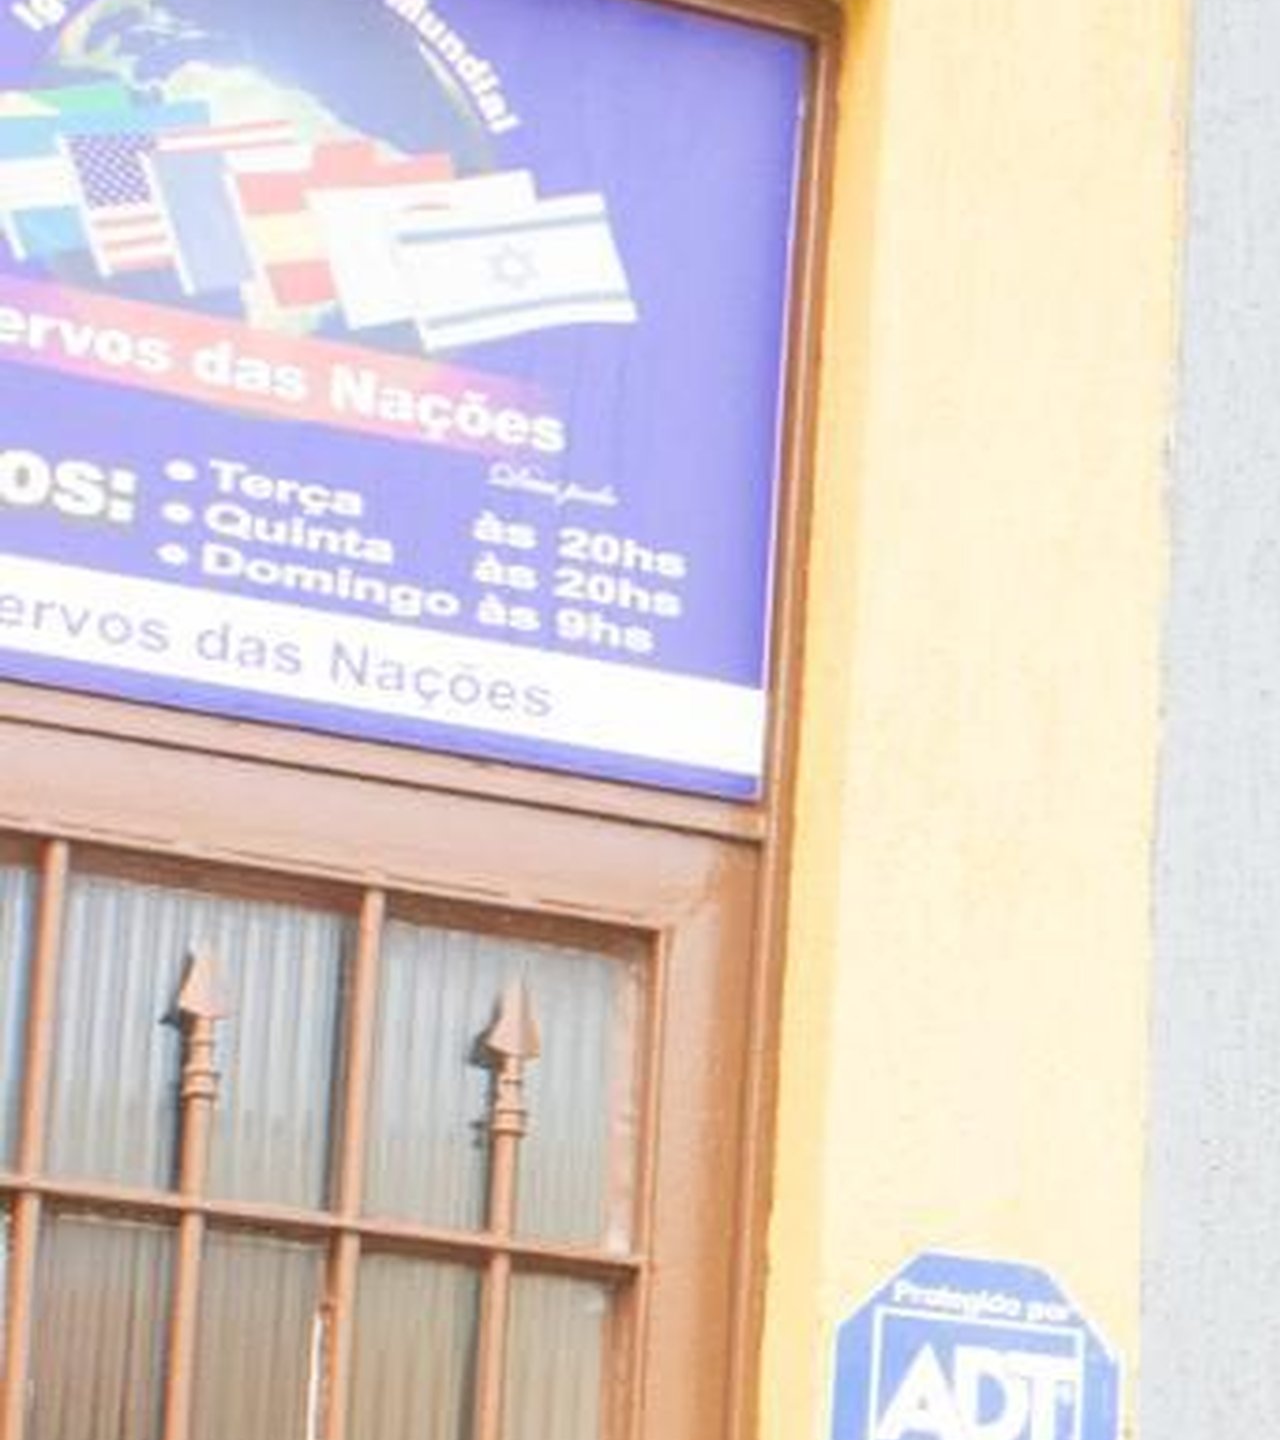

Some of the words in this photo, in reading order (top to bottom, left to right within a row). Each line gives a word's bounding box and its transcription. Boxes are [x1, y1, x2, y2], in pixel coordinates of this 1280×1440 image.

[192, 340, 307, 403] das
[330, 363, 566, 453] Nações
[203, 503, 395, 566] Quinta
[473, 550, 540, 591] às
[552, 567, 684, 619] 20hs
[208, 459, 366, 518] Terça
[471, 509, 537, 550] às
[556, 526, 688, 579] 20hs
[201, 542, 461, 618] Domingo
[476, 592, 542, 632] às
[554, 606, 656, 654] 9hs
[196, 620, 303, 677] das
[329, 639, 556, 718] Nações
